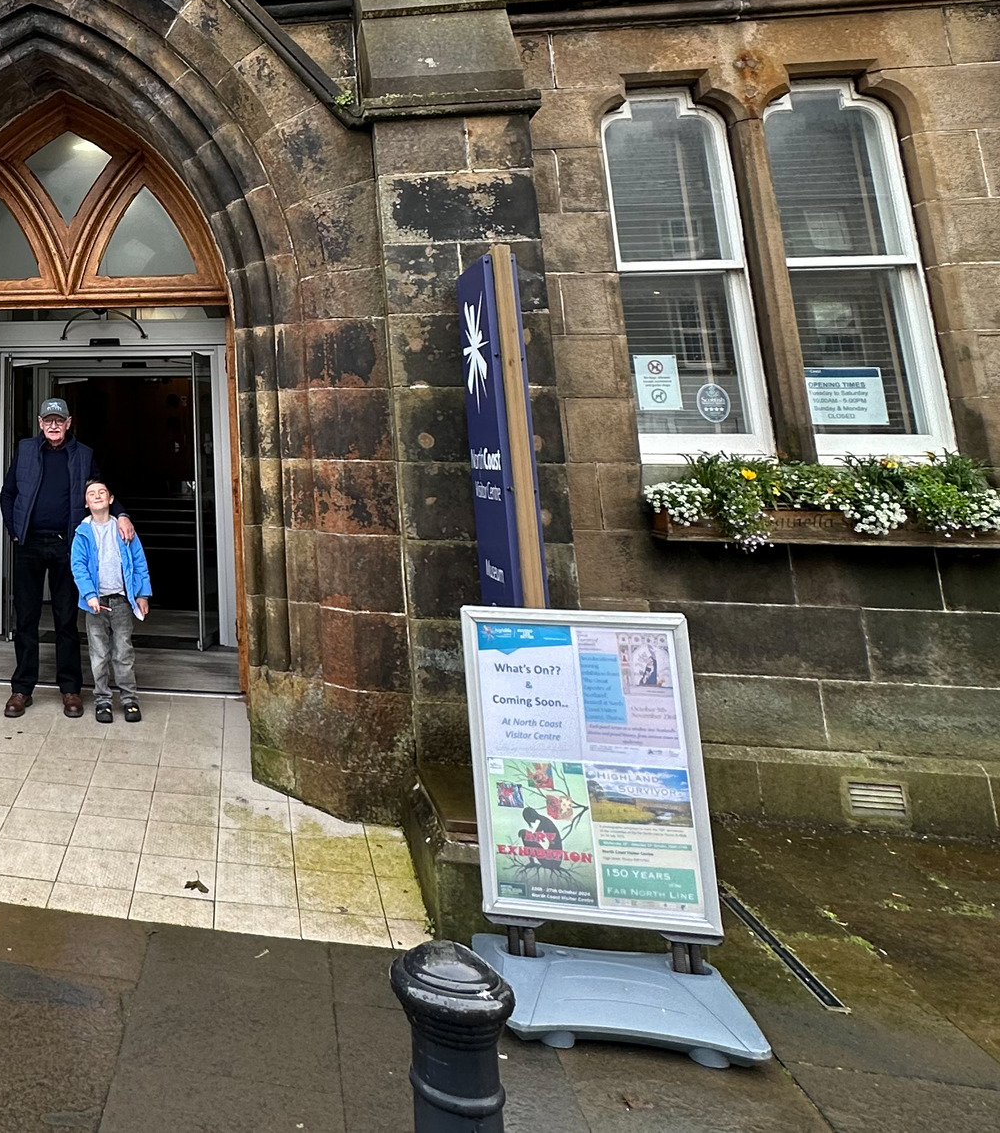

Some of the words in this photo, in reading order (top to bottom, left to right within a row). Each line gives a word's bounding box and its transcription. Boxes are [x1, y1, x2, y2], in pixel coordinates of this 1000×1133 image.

[494, 662, 532, 674] What's
[533, 665, 561, 675] On??
[525, 681, 533, 689] &
[492, 694, 533, 707] Coming
[502, 717, 511, 726] At
[512, 717, 538, 727] North
[539, 720, 563, 729] Coast
[505, 731, 532, 740] Visitor
[533, 732, 562, 742] Centre
[524, 831, 556, 844] ART
[496, 844, 592, 864] EXHIBITION
[606, 868, 629, 878] 150
[631, 870, 671, 881] YEARS
